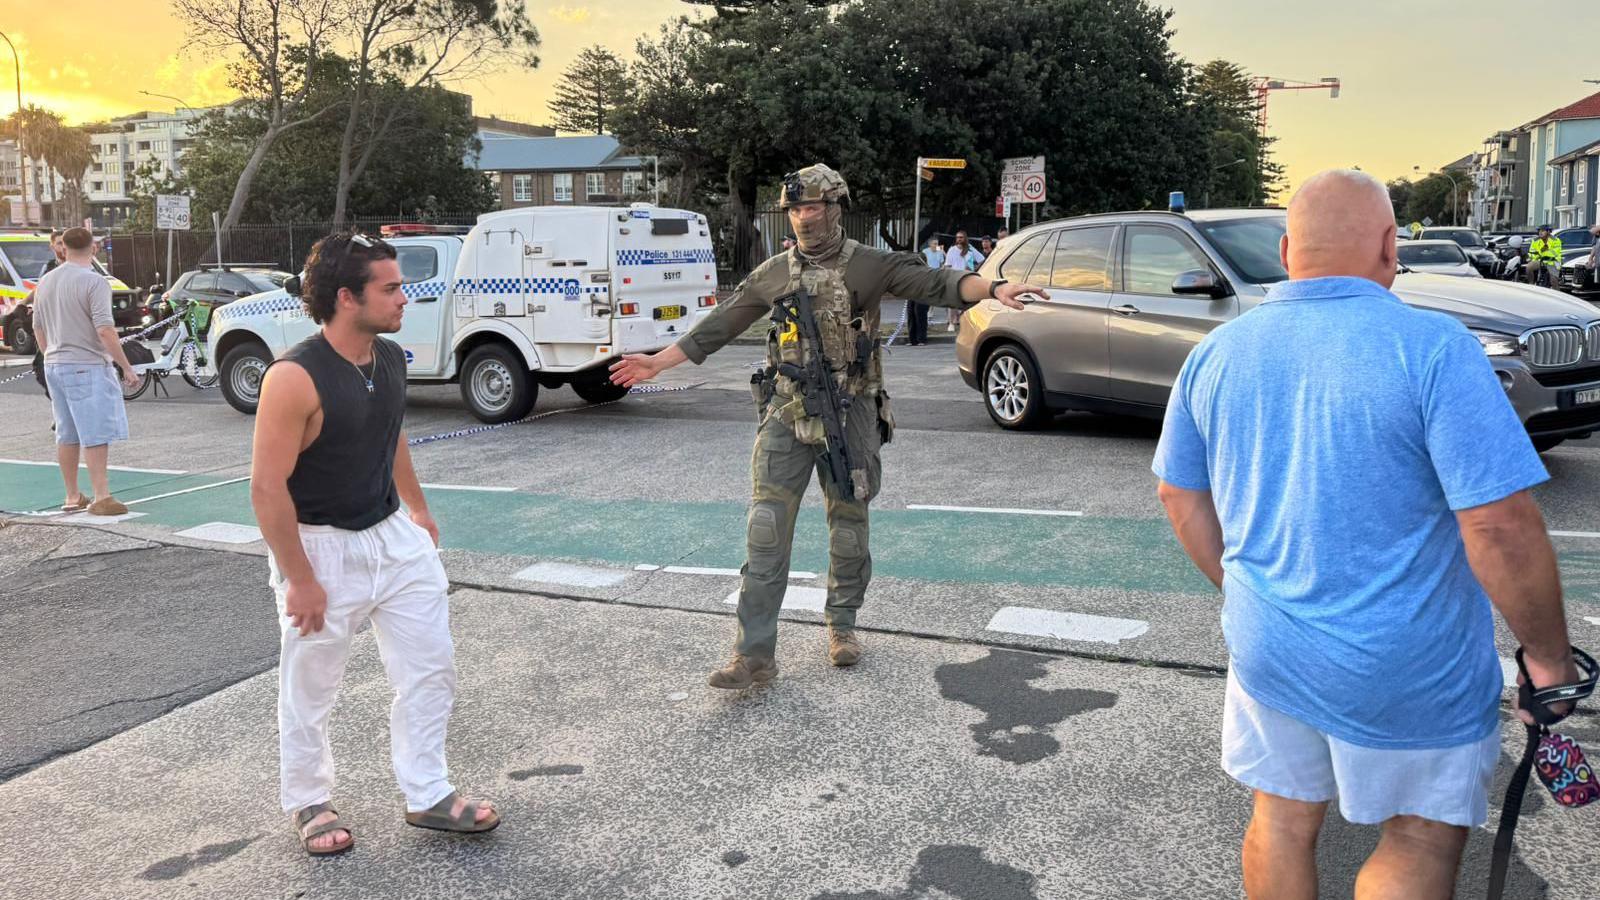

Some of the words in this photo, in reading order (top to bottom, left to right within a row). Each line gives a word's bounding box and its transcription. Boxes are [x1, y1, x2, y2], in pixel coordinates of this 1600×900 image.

[1027, 182, 1041, 193] 40
[176, 213, 188, 223] 40
[644, 250, 668, 259] Police
